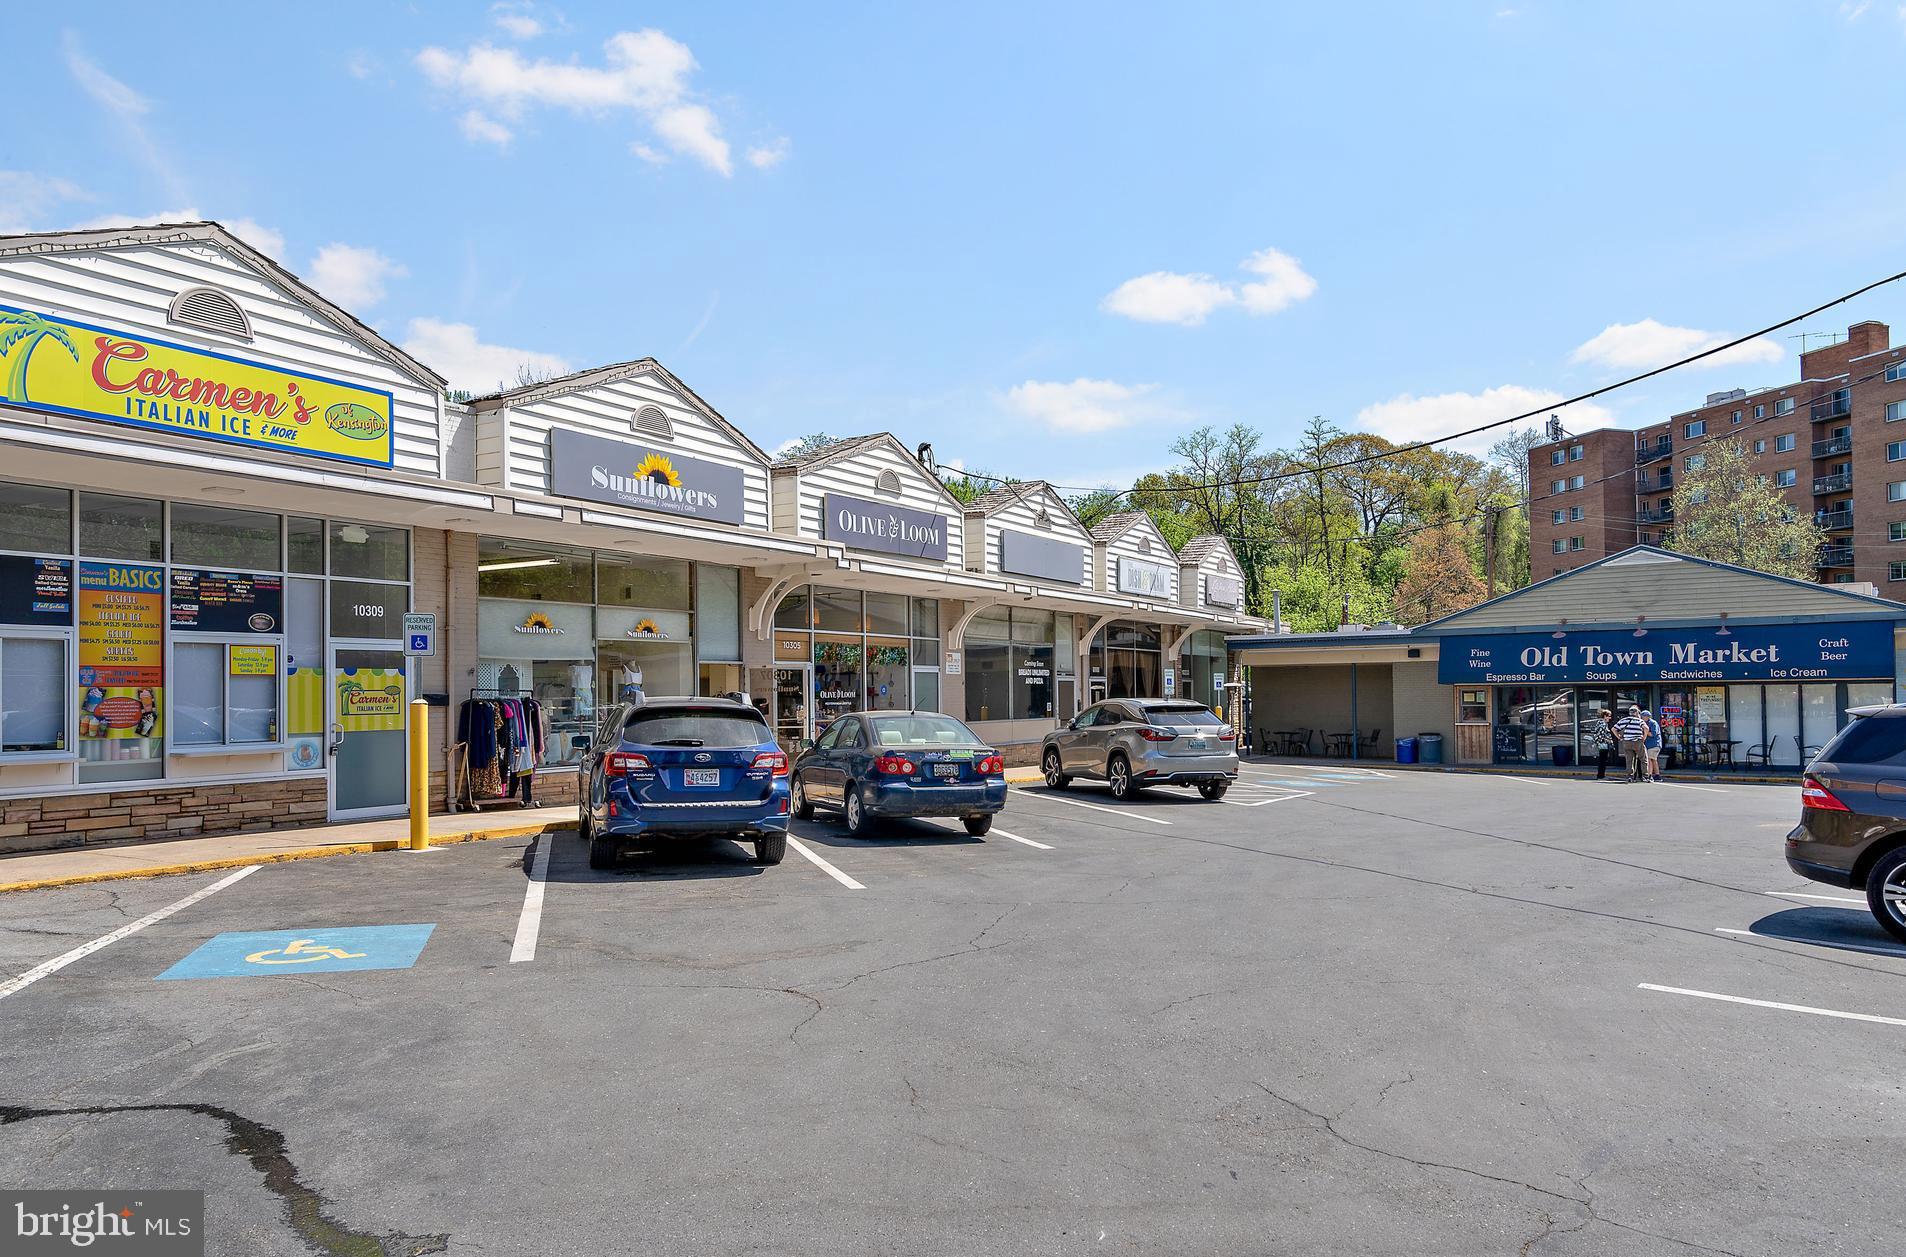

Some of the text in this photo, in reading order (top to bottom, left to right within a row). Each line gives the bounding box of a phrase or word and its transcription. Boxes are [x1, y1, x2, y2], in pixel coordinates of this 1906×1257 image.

[92, 336, 320, 425] Carmen's
[341, 404, 354, 416] of
[126, 397, 298, 440] ITALIAN ICE & MORE
[327, 411, 388, 434] Kensington
[591, 464, 718, 509] Sunflowers
[618, 493, 656, 506] Consignments
[661, 500, 680, 512] Jewelry
[838, 509, 940, 546] OLIVE & LOOM
[80, 576, 107, 585] menu
[109, 568, 161, 589] BASICS
[352, 605, 384, 617] 10309
[514, 624, 565, 635] Sunflowers
[627, 630, 669, 639] Sunflowers
[783, 641, 801, 649] 10305
[1819, 638, 1849, 648] Craft
[1471, 649, 1490, 657] Fine
[1520, 641, 1780, 668] Old Town Market
[1820, 652, 1848, 660] Beer
[1469, 660, 1492, 668] Wine
[1486, 668, 1828, 682] Espresso Bar Soups Sandwiches Ice Cream
[350, 691, 397, 704] Carmen's
